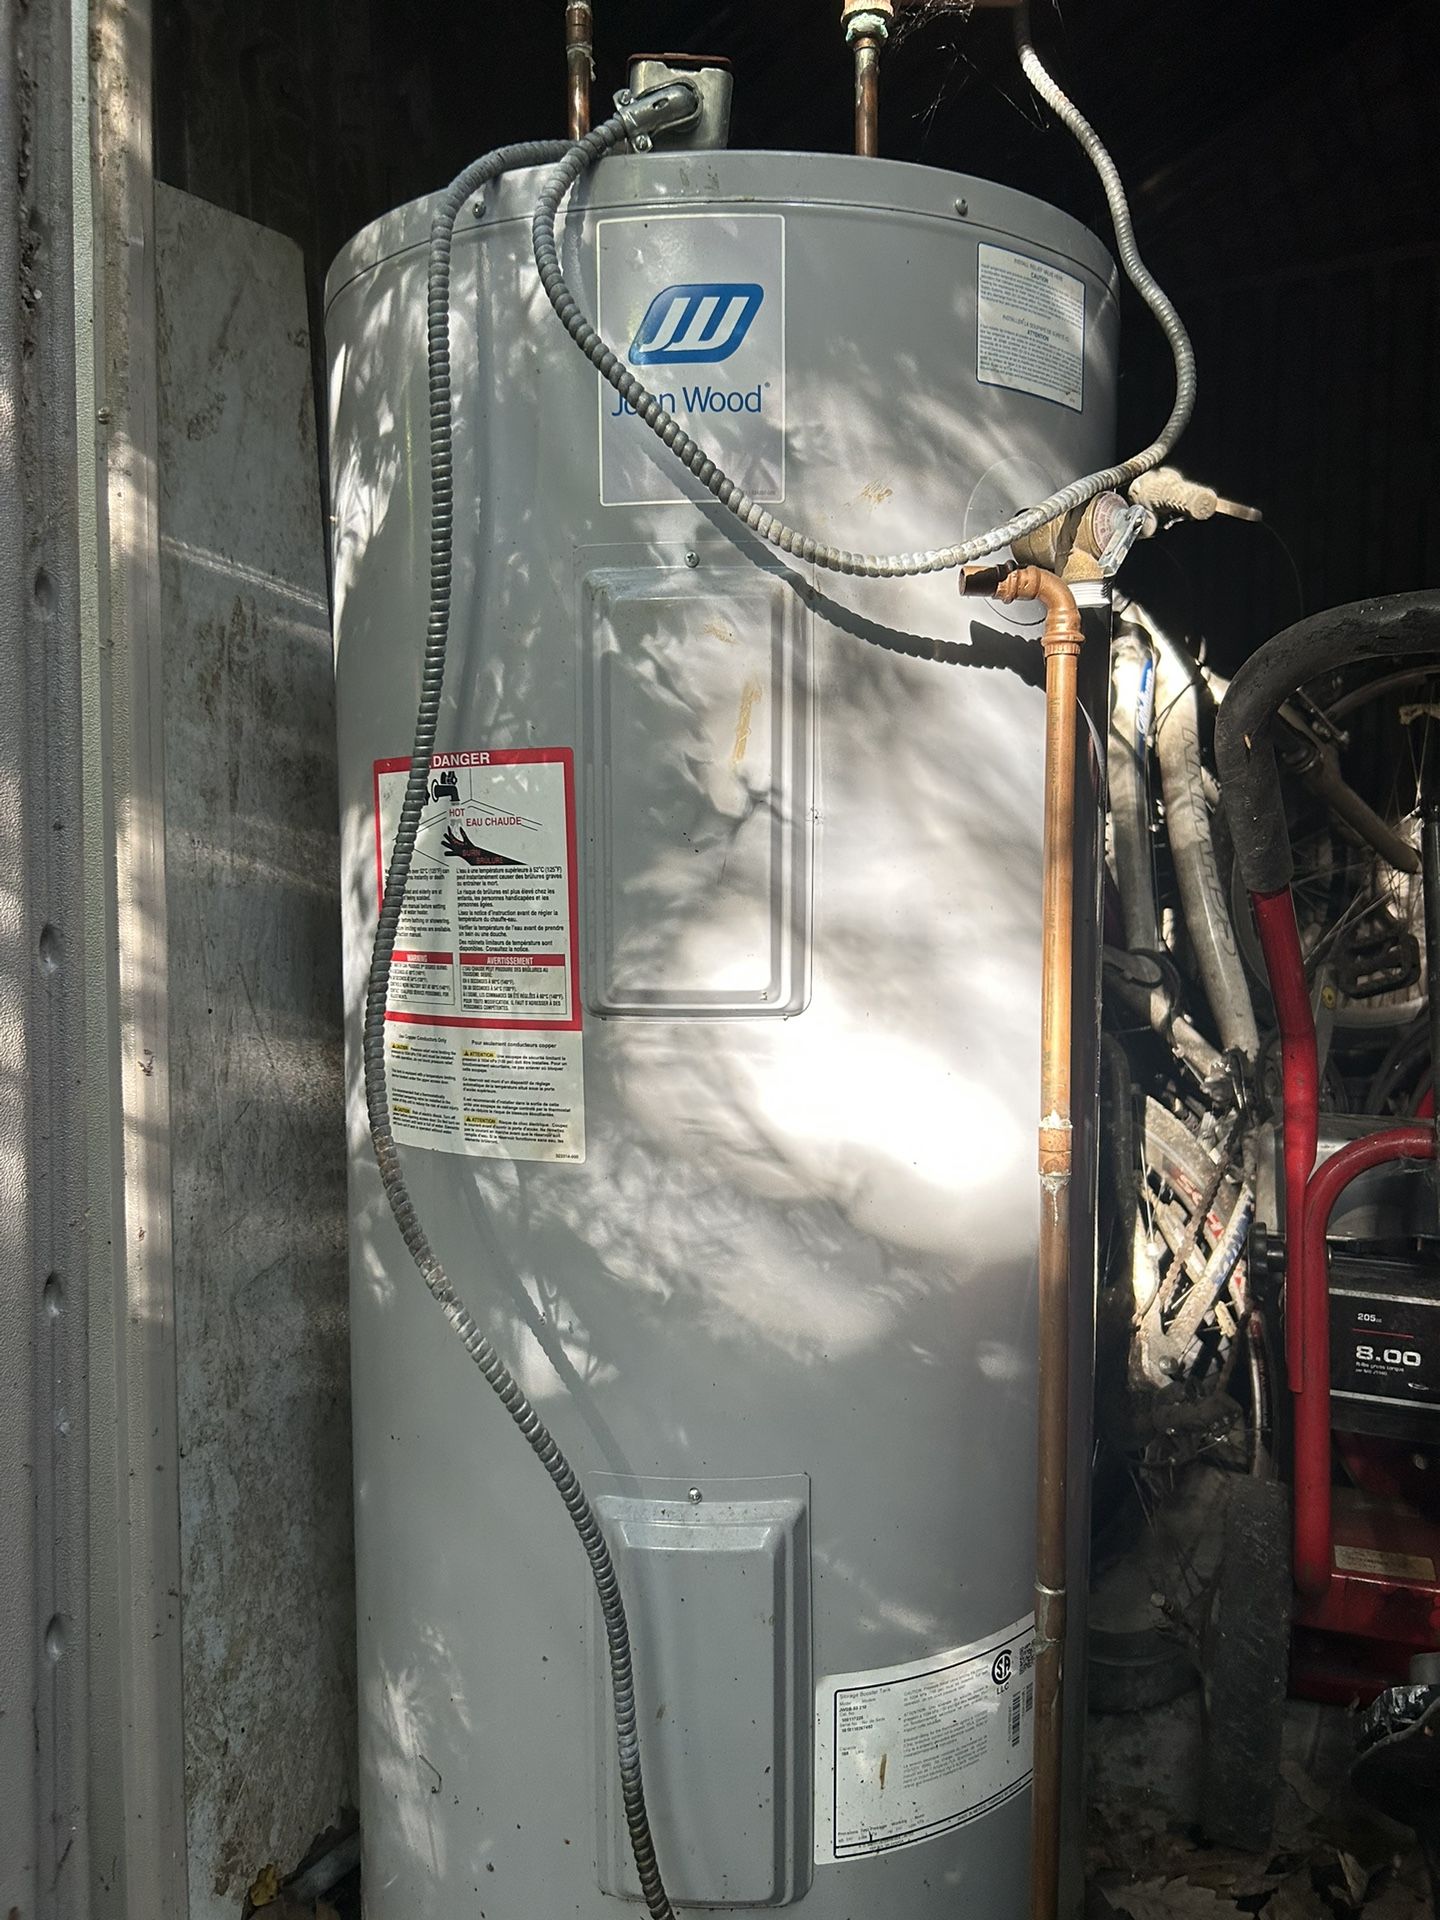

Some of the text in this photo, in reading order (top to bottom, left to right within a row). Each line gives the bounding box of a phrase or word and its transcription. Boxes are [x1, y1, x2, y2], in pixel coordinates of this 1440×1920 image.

[682, 384, 761, 413] Wood
[433, 752, 490, 767] DANGER
[449, 808, 465, 817] HOT
[466, 816, 522, 827] EAU CHAUDE
[487, 956, 534, 965] AVERTISSEMENT
[1355, 1345, 1421, 1367] 8.00
